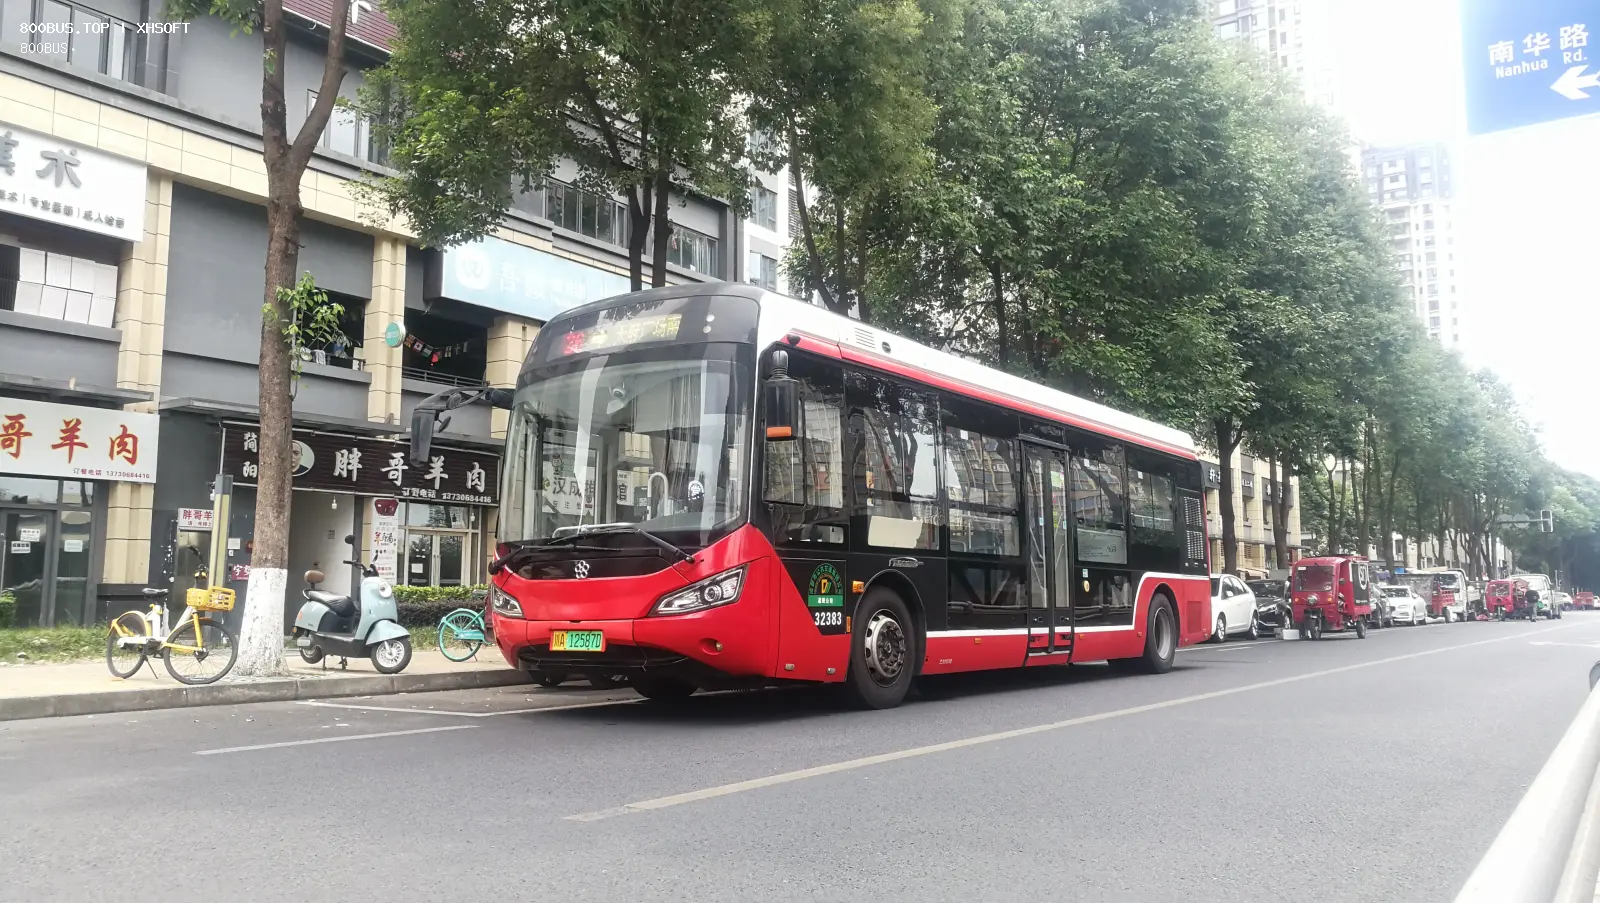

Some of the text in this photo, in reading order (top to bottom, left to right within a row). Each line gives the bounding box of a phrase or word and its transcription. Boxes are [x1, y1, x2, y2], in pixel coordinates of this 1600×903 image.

[1488, 24, 1589, 66] 南华路
[1496, 48, 1588, 79] Nanhua Rd.
[0, 413, 138, 466] 哥羊肉
[333, 447, 486, 493] 胖哥羊肉
[814, 612, 842, 626] 32383
